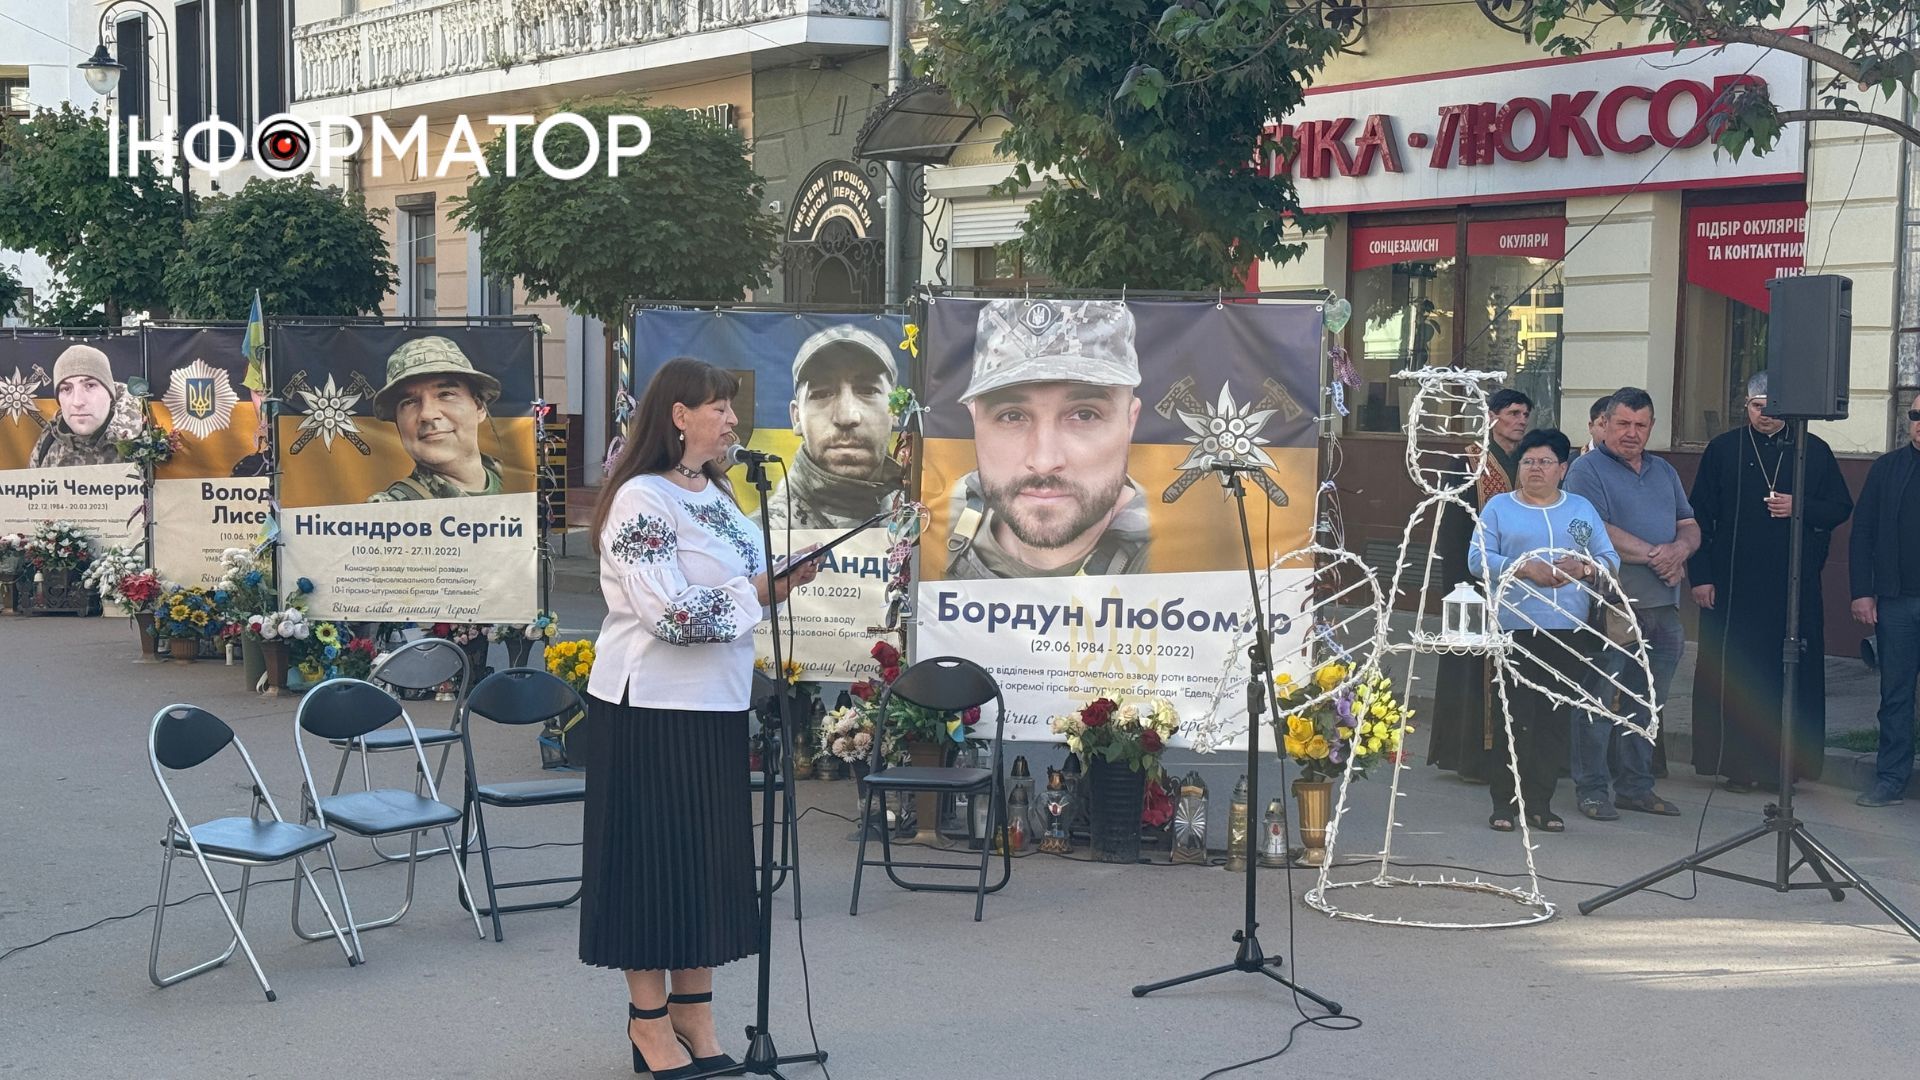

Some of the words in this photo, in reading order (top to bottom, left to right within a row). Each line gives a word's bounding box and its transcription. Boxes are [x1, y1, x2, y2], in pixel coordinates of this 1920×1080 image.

[833, 170, 871, 200] ГРОШОВІ
[793, 177, 825, 233] WESTERN
[804, 192, 828, 227] UNION
[833, 186, 872, 228] ПЕРЕКАЗИ
[1697, 220, 1740, 239] ПІДБІР
[1743, 217, 1806, 236] ОКУЛЯРІВ
[1369, 238, 1439, 256] СОНЦЕЗАХИСНІ
[1500, 233, 1549, 249] ОКУЛЯРИ
[1708, 245, 1721, 260] ТА
[1725, 242, 1805, 260] КОНТАКТНИХ
[295, 514, 432, 542] Нікандров
[440, 515, 523, 543] Сергій
[352, 546, 401, 556] (10.06.1972
[411, 546, 461, 557] 27.11.2022)
[345, 564, 379, 573] Командир
[439, 565, 468, 574] розвідки
[410, 586, 439, 596] бригади
[332, 602, 360, 613] Вічна
[365, 602, 393, 614] слава
[398, 605, 441, 618] нашому
[938, 591, 1084, 635] Бордун
[824, 616, 856, 625] взводу
[1030, 640, 1105, 654] (29.06.1984
[1116, 643, 1195, 660] 23.09.2022)
[996, 665, 1044, 676] відділення
[1047, 668, 1124, 680] гранатометного
[1126, 671, 1159, 683] взводу
[1161, 674, 1185, 684] роти
[1005, 682, 1044, 693] окремої
[1046, 683, 1135, 696] гірсько-штурової
[1137, 685, 1177, 698] бригади
[1001, 710, 1039, 725] ічна
